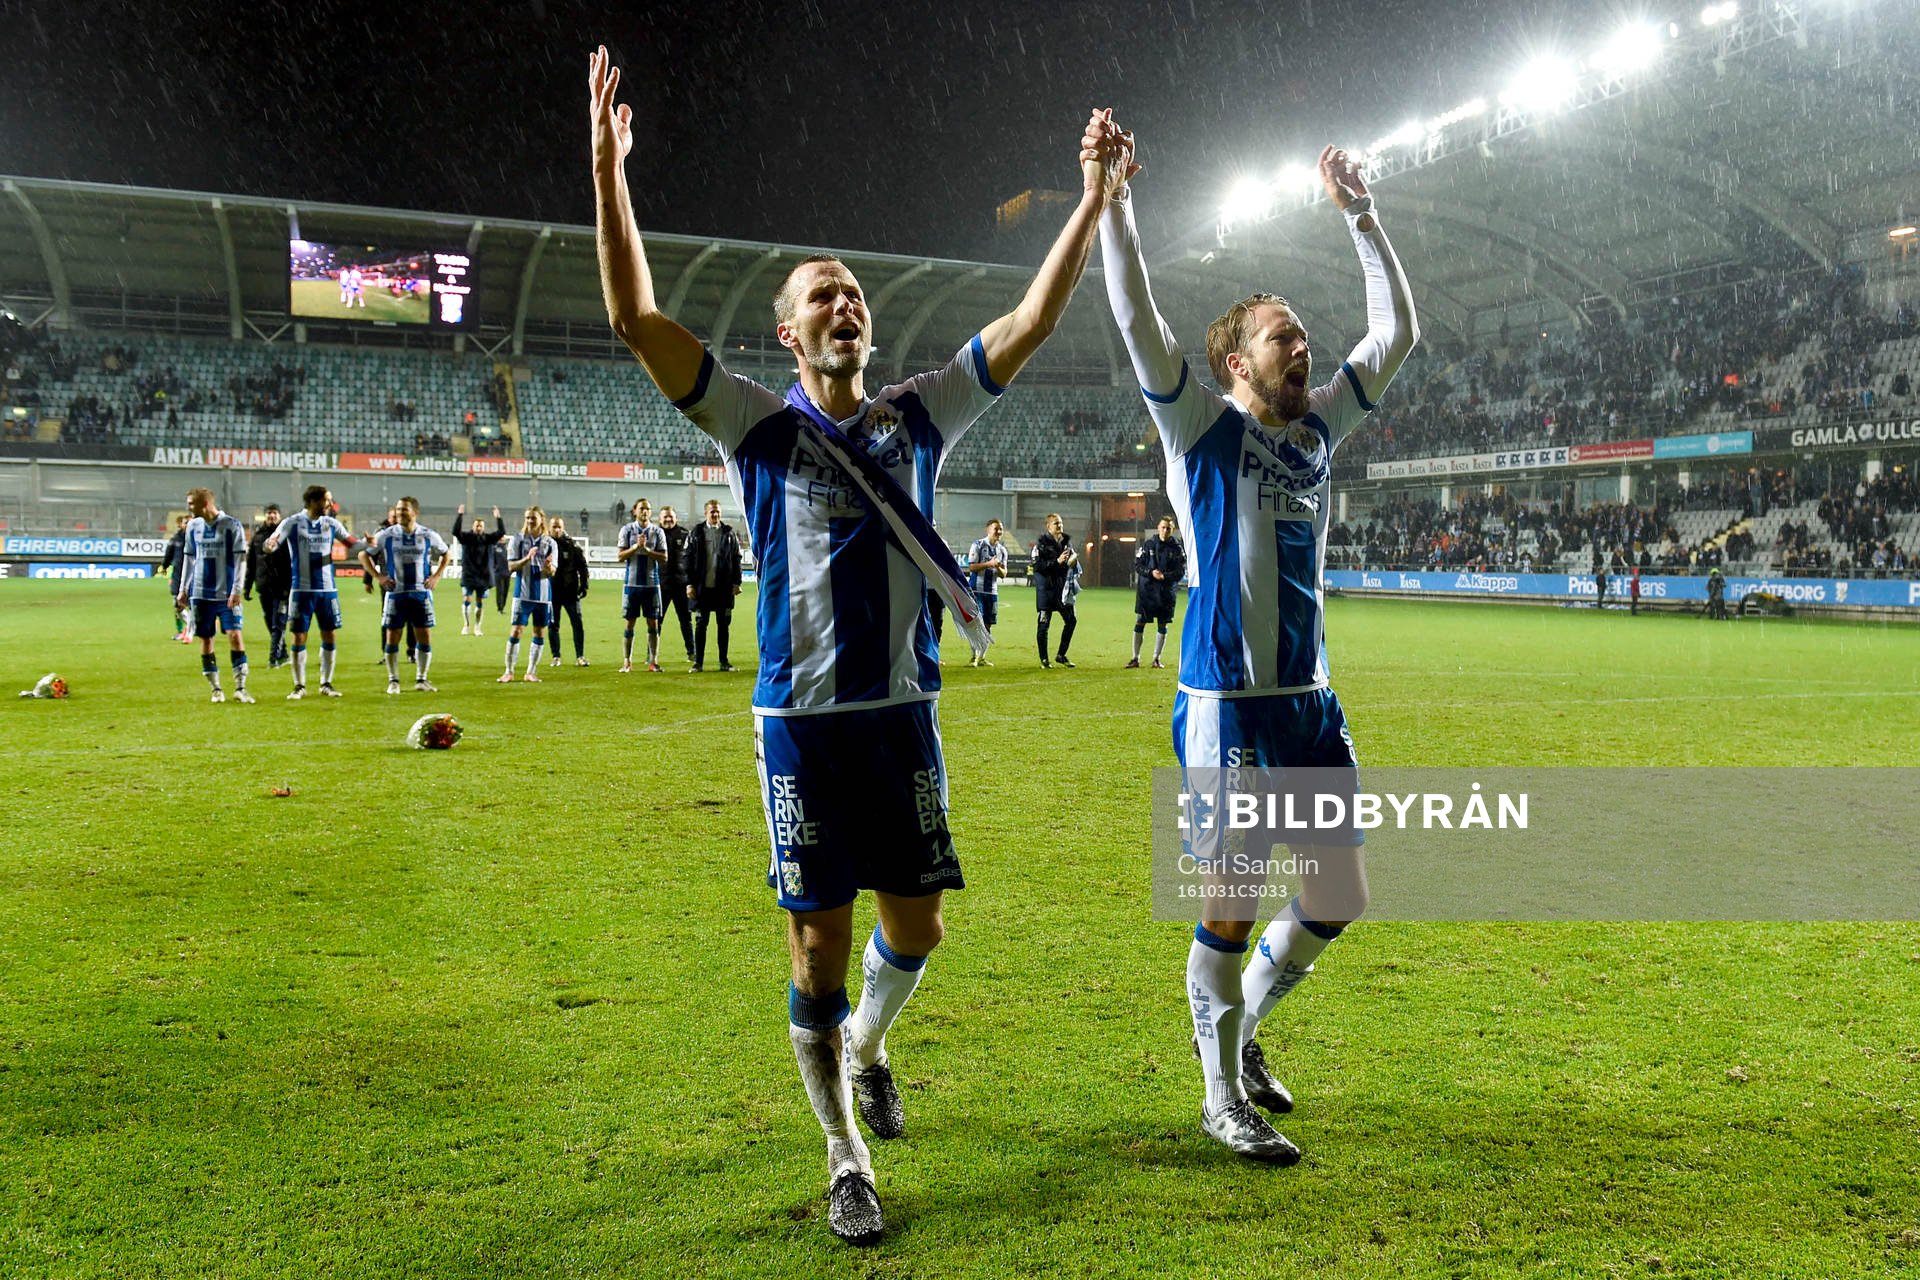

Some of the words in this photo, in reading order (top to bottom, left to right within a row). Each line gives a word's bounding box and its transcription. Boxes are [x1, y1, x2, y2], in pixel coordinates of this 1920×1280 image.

[1791, 426, 1858, 447] GAMLA
[153, 448, 204, 465] ANTA
[208, 449, 327, 468] UTMANINGEN
[368, 457, 588, 477] www.ulleviarenachallenge.se
[624, 464, 659, 481] 5km
[683, 466, 703, 481] 60
[7, 539, 120, 554] EHRENBORG
[35, 564, 146, 579] onninen
[1471, 574, 1517, 591] Kappa
[1226, 746, 1255, 769] SE
[771, 774, 798, 799] SE
[913, 767, 940, 793] SE
[1225, 768, 1257, 791] RN
[774, 798, 804, 822] RN
[919, 810, 948, 834] EK
[775, 822, 819, 846] EKE
[932, 838, 956, 865] 14
[1267, 960, 1306, 999] SKF
[1191, 982, 1214, 1040] SKF
